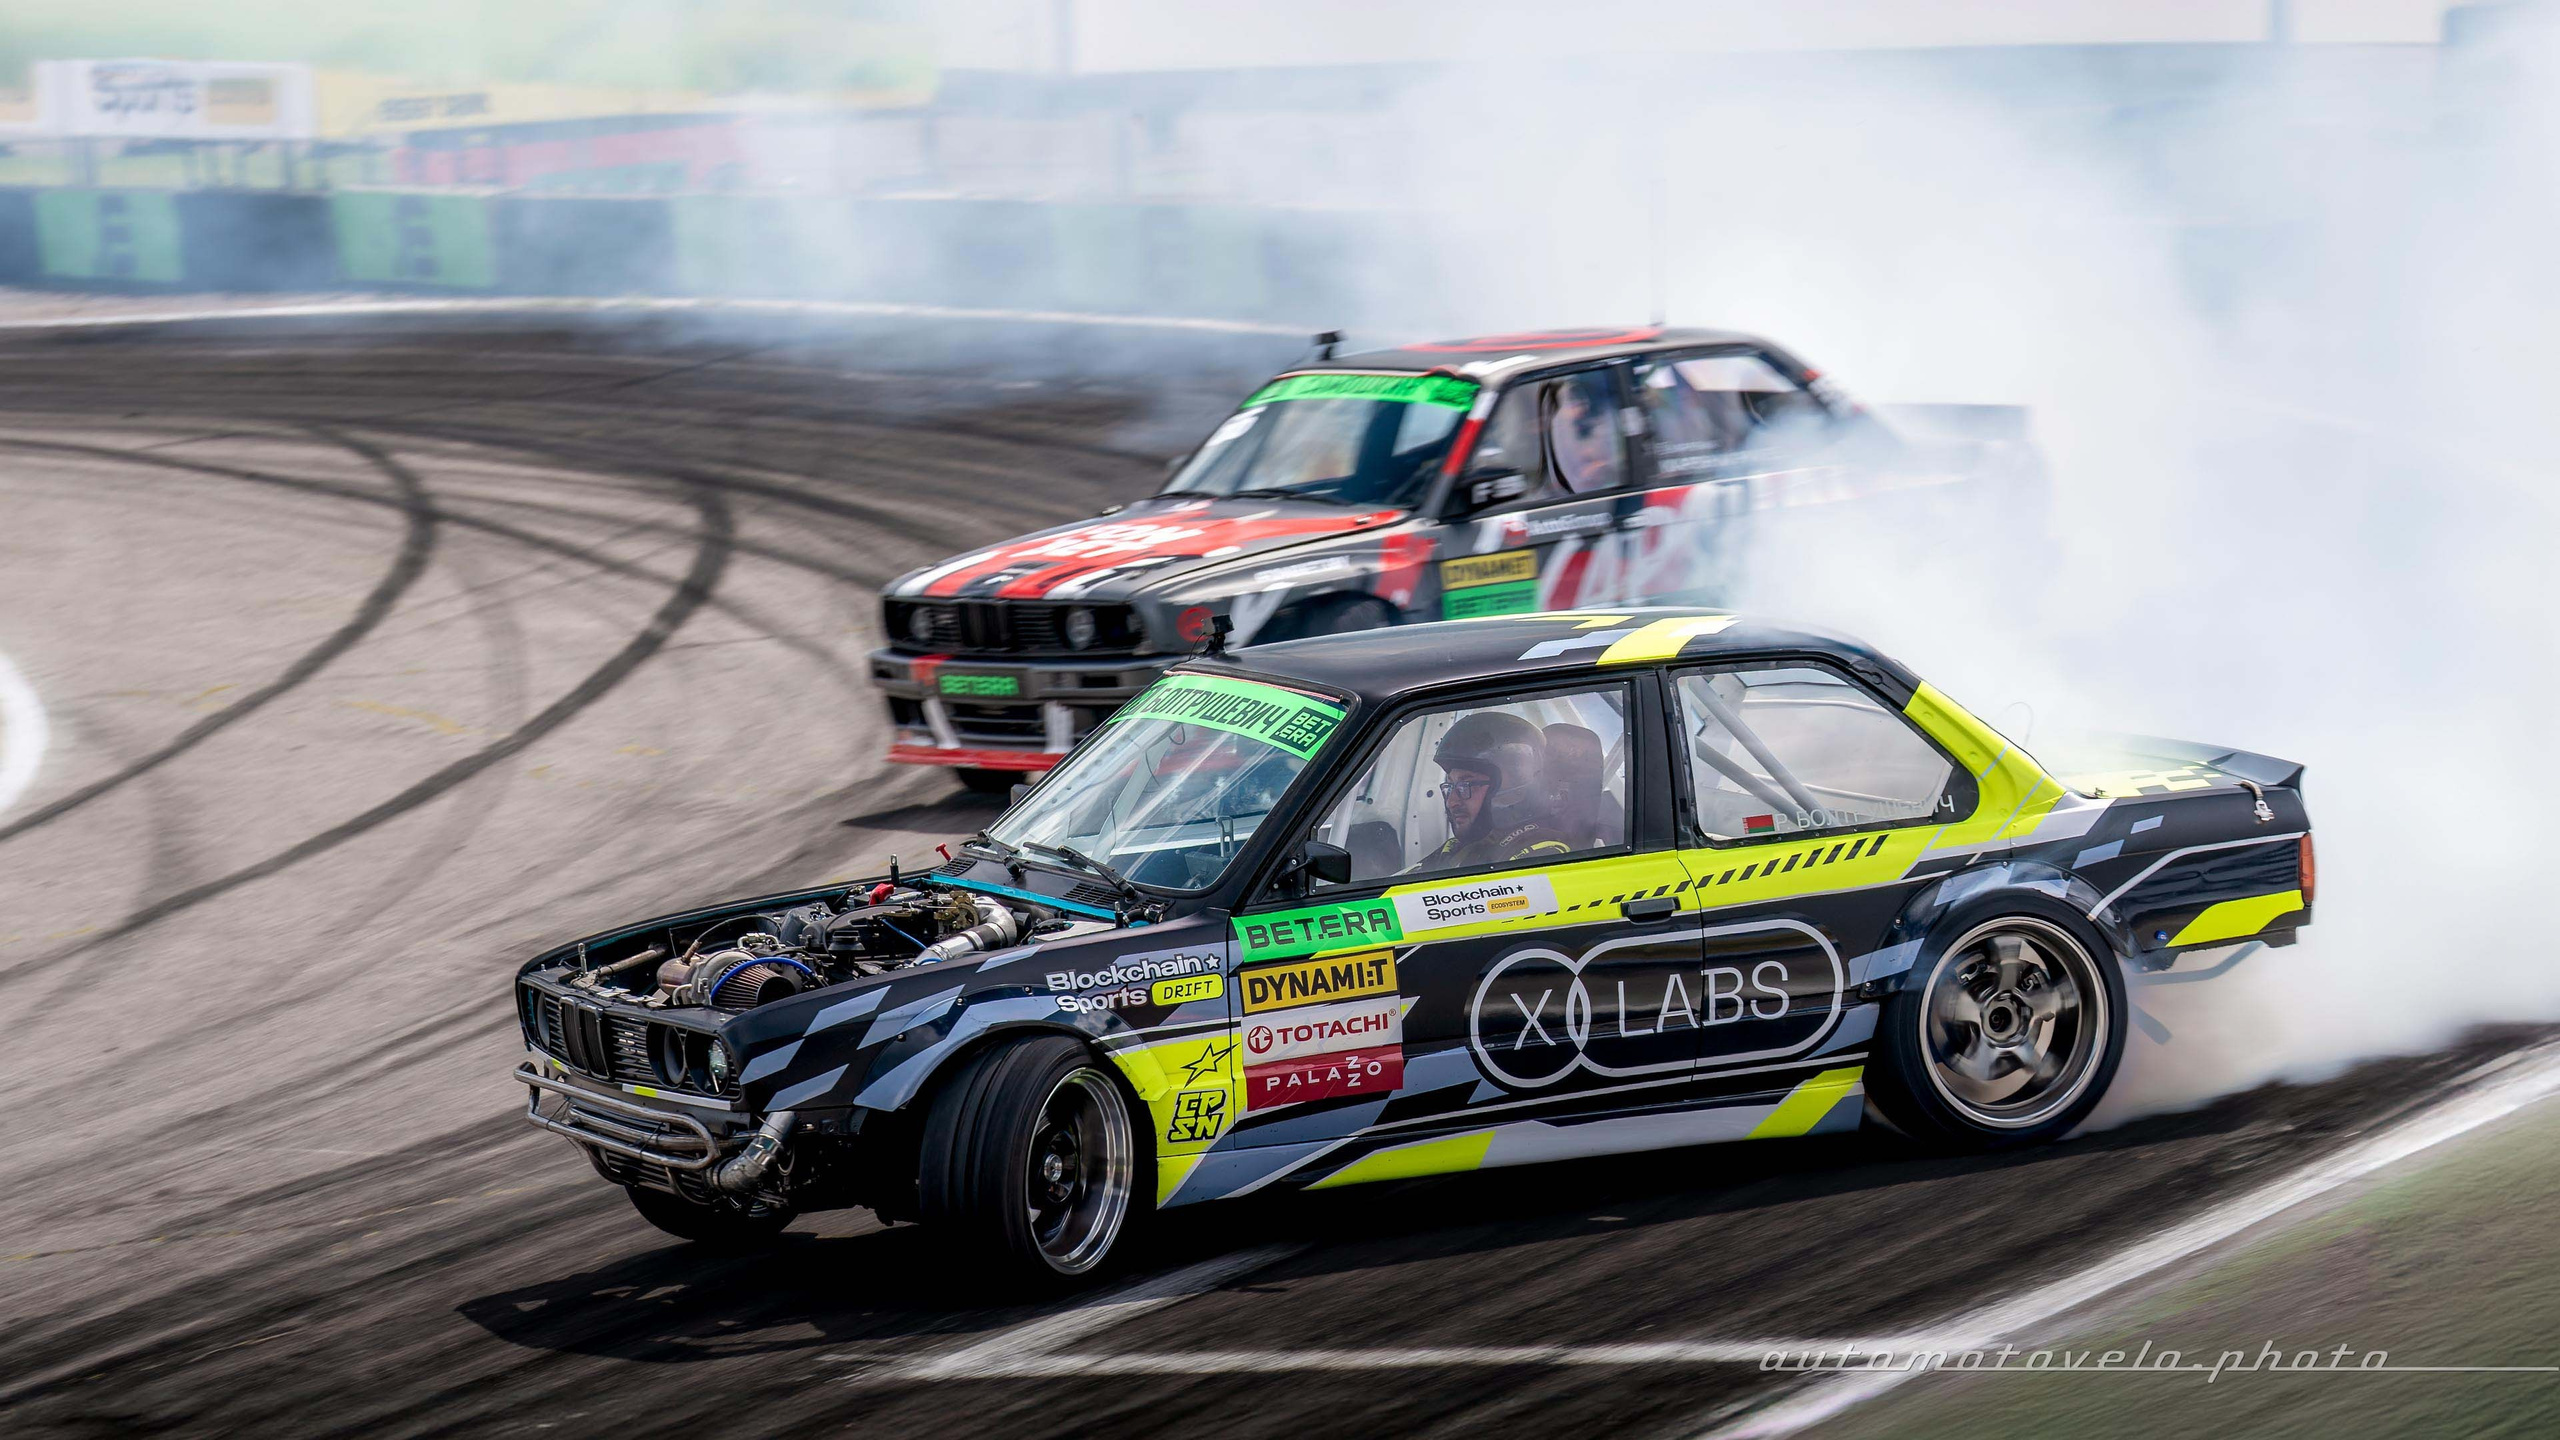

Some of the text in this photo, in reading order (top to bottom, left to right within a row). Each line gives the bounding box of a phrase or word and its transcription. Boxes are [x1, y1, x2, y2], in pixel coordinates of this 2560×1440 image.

[1140, 687, 1290, 734] БОЛТРУШЕВИЧ
[1291, 711, 1333, 733] BET
[1422, 885, 1514, 907] Blockchain
[1427, 899, 1526, 921] Sports ECOSYSTEM
[1046, 954, 1202, 991] Blockchain
[1056, 980, 1213, 1015] Sports DRIFT
[1510, 960, 1790, 1050] X LABS
